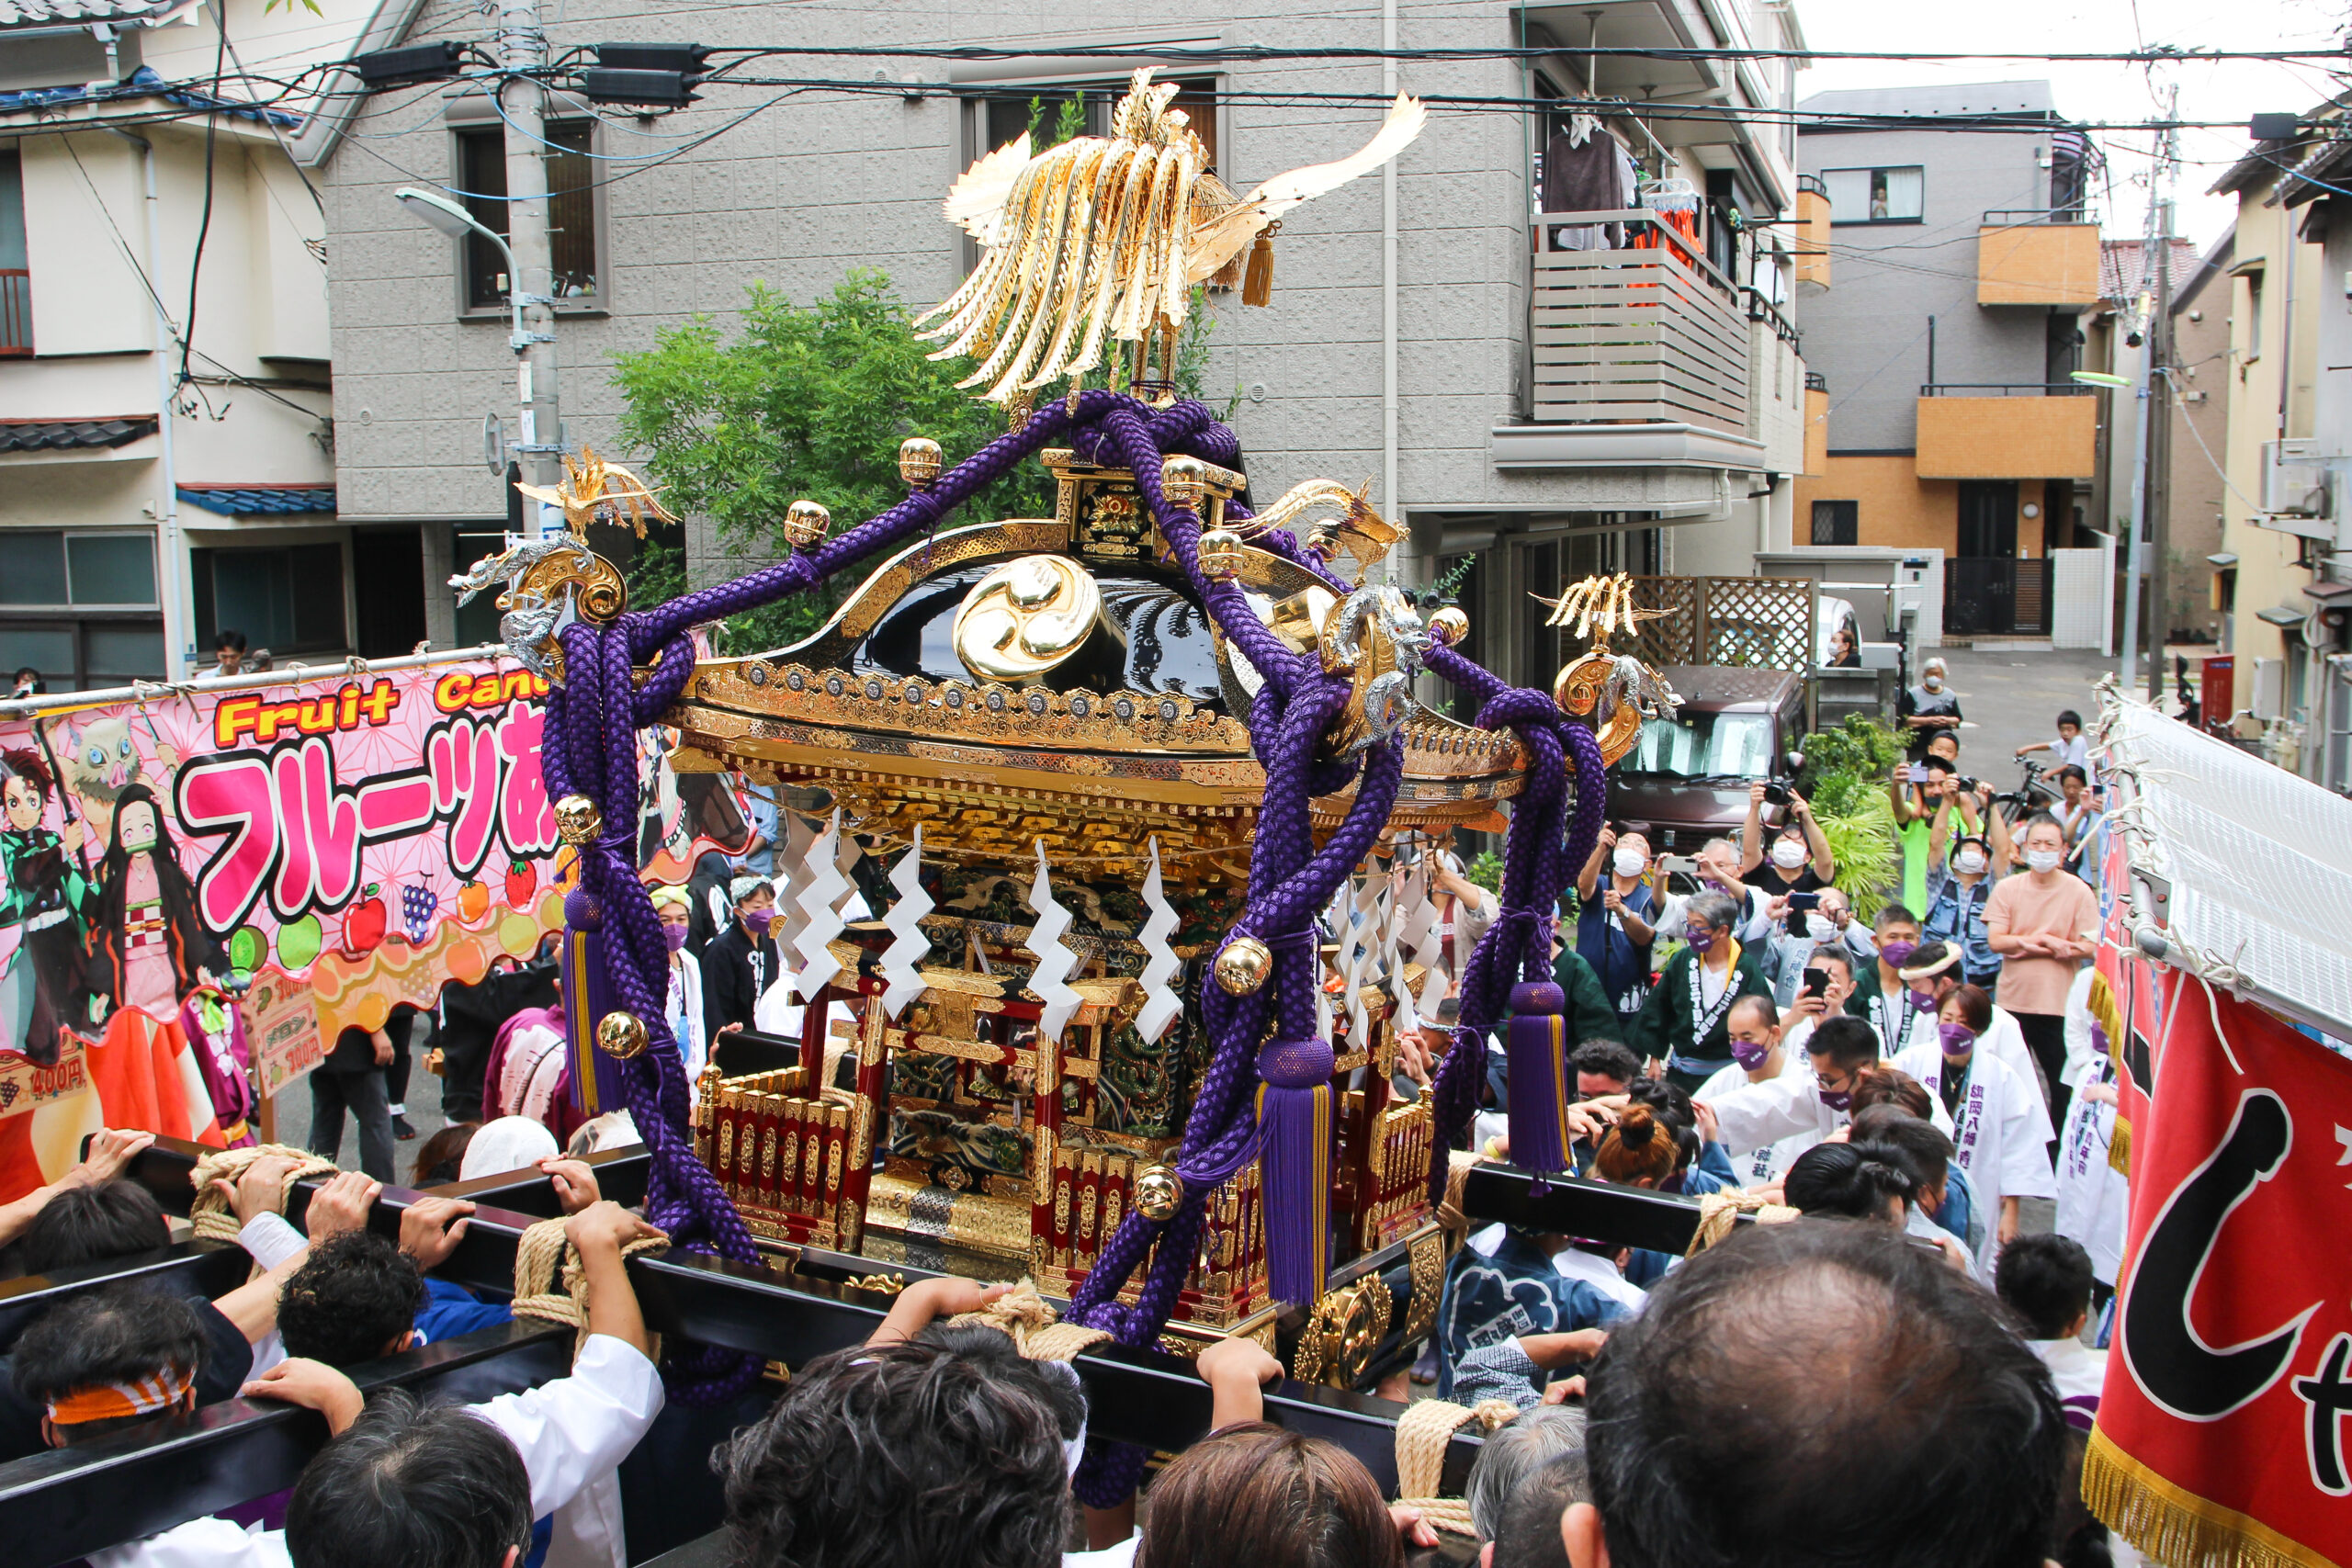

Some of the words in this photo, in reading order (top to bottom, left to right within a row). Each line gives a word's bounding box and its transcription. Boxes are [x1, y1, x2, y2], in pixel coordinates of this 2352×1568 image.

[215, 678, 400, 749] Fruit
[266, 1016, 307, 1050] メロン
[286, 1035, 322, 1075] 300円
[30, 1056, 83, 1100] 400円
